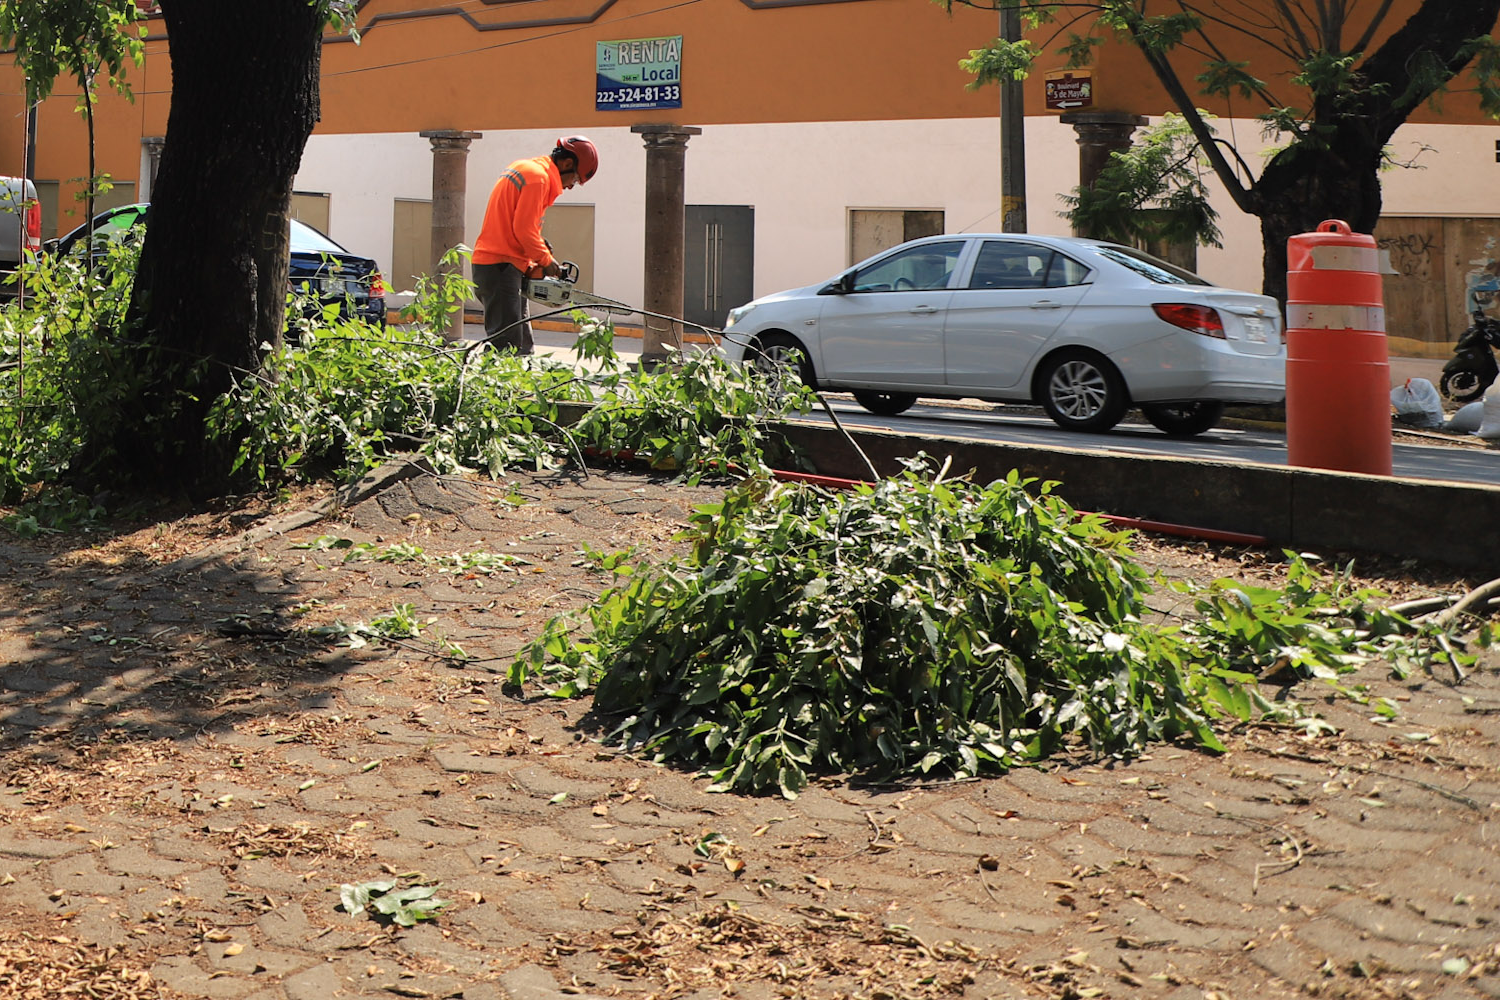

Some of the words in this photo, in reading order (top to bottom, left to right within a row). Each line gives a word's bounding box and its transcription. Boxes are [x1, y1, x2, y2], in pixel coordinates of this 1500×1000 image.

[618, 39, 679, 65] RENTA
[642, 64, 678, 81] Local
[597, 86, 679, 102] 222-524-81-33
[1057, 82, 1079, 90] Boulevard
[1054, 91, 1059, 99] 5
[1059, 90, 1067, 98] de
[1068, 90, 1085, 98] Mayo
